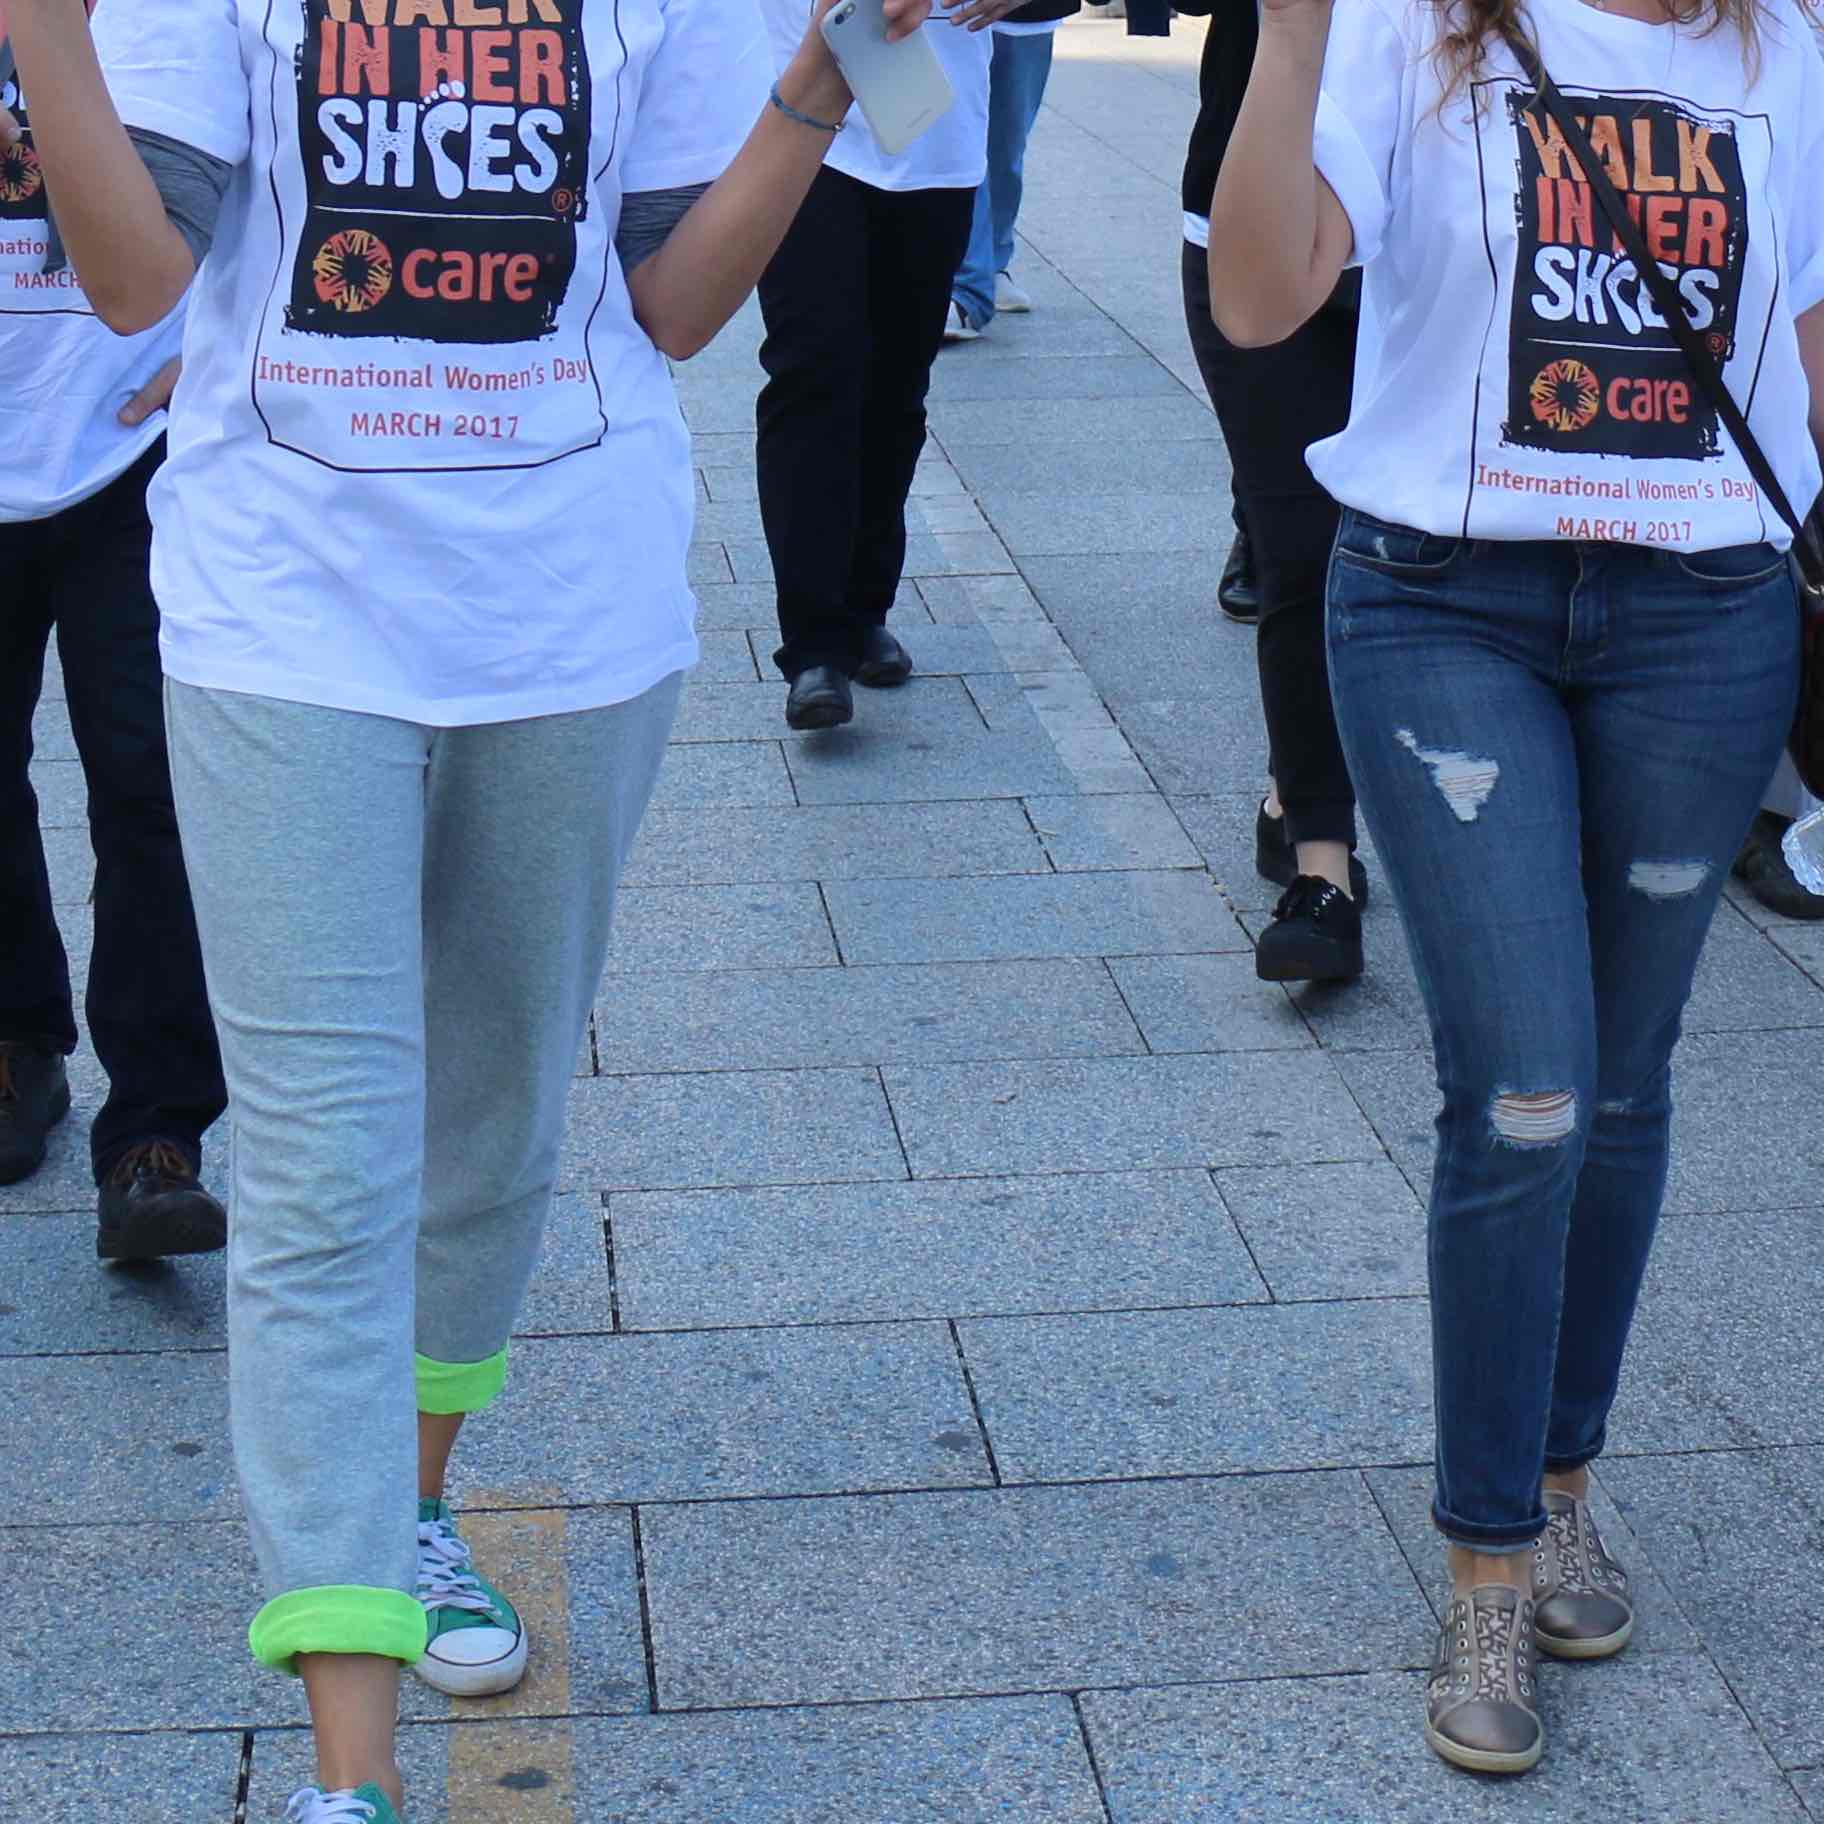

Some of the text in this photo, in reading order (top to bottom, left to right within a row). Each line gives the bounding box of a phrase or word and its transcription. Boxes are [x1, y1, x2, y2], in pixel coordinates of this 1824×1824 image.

[316, 18, 567, 106] IN HER
[316, 88, 566, 200] SHOES
[1535, 178, 1594, 245] IN
[400, 247, 540, 303] care
[258, 355, 588, 392] International Women's Day
[1605, 375, 1691, 423] care
[349, 412, 520, 440] MARCH 2017
[1476, 463, 1755, 503] International Women's Day
[1555, 519, 1693, 542] MARCH 2017
